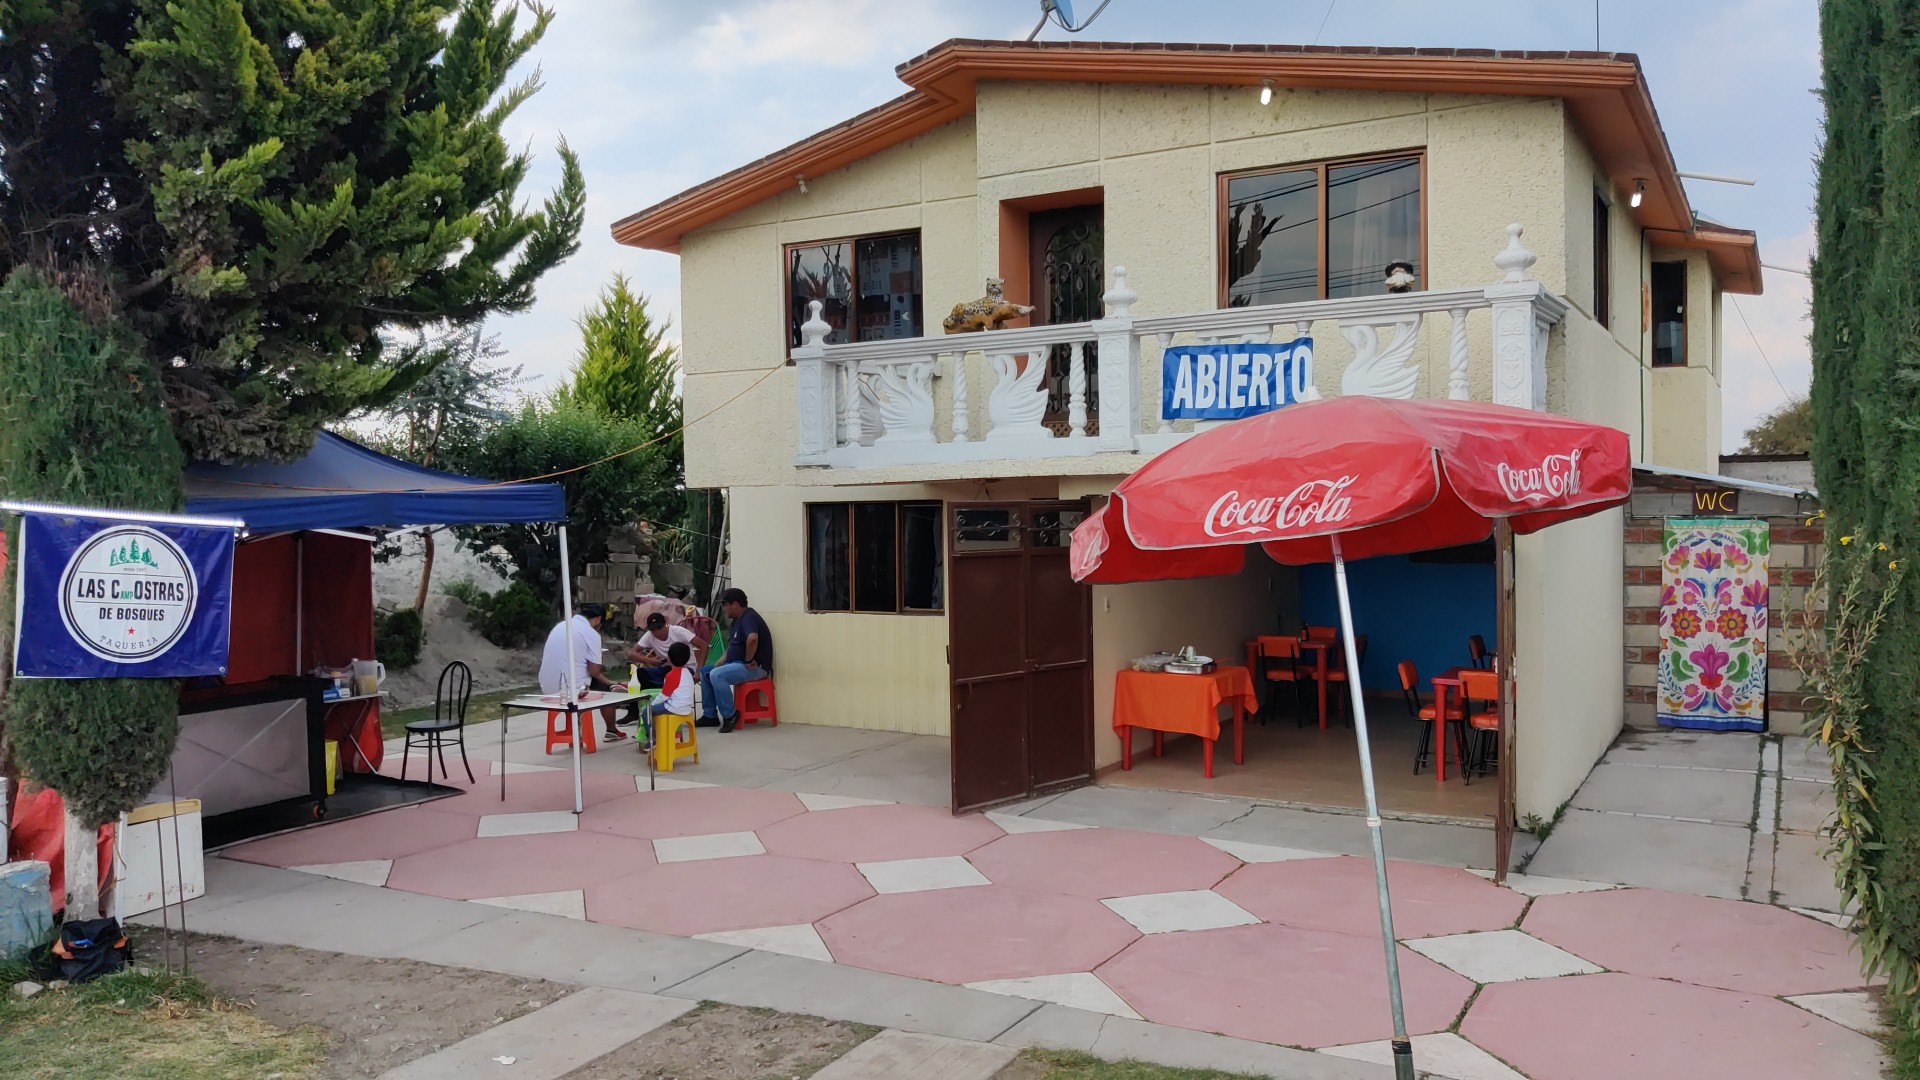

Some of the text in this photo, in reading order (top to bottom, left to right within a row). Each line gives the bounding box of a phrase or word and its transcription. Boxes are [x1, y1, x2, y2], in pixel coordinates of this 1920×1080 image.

[1172, 345, 1313, 409] ABIERTO
[1497, 447, 1584, 502] Coca-Cola
[1204, 474, 1361, 537] Coca-Cola
[1695, 491, 1735, 512] WC
[77, 578, 106, 599] LAS
[99, 607, 165, 621] DE BOSQUES
[99, 635, 159, 650] TAQUERIA
